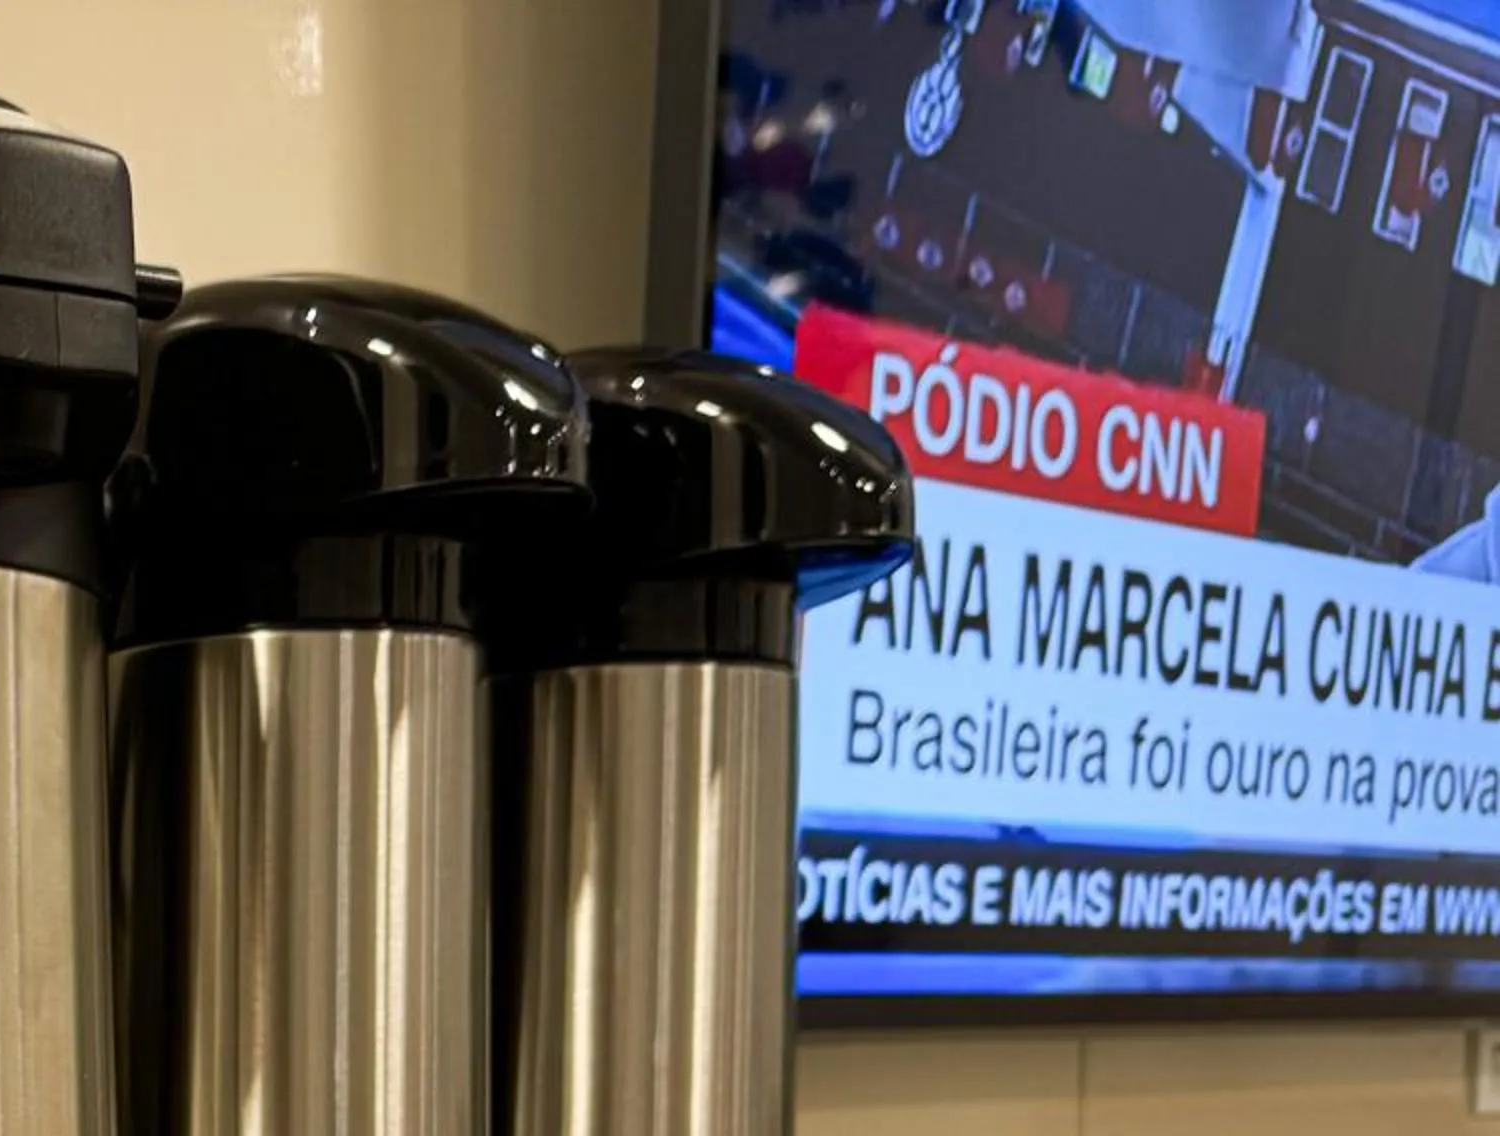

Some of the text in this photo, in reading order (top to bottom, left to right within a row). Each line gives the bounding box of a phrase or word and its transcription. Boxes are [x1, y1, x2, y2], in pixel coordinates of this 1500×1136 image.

[869, 343, 1222, 508] PÓDIO CNN
[853, 536, 991, 662] ANA
[1017, 551, 1287, 697] MARCELA
[1309, 598, 1466, 719] CUNHA
[847, 688, 1500, 825] Brasileira foi ouro na prova
[971, 864, 1003, 924] E
[1010, 866, 1113, 928] MAIS
[1120, 869, 1376, 943] INFORMAÇÕES
[1380, 884, 1428, 934] EM
